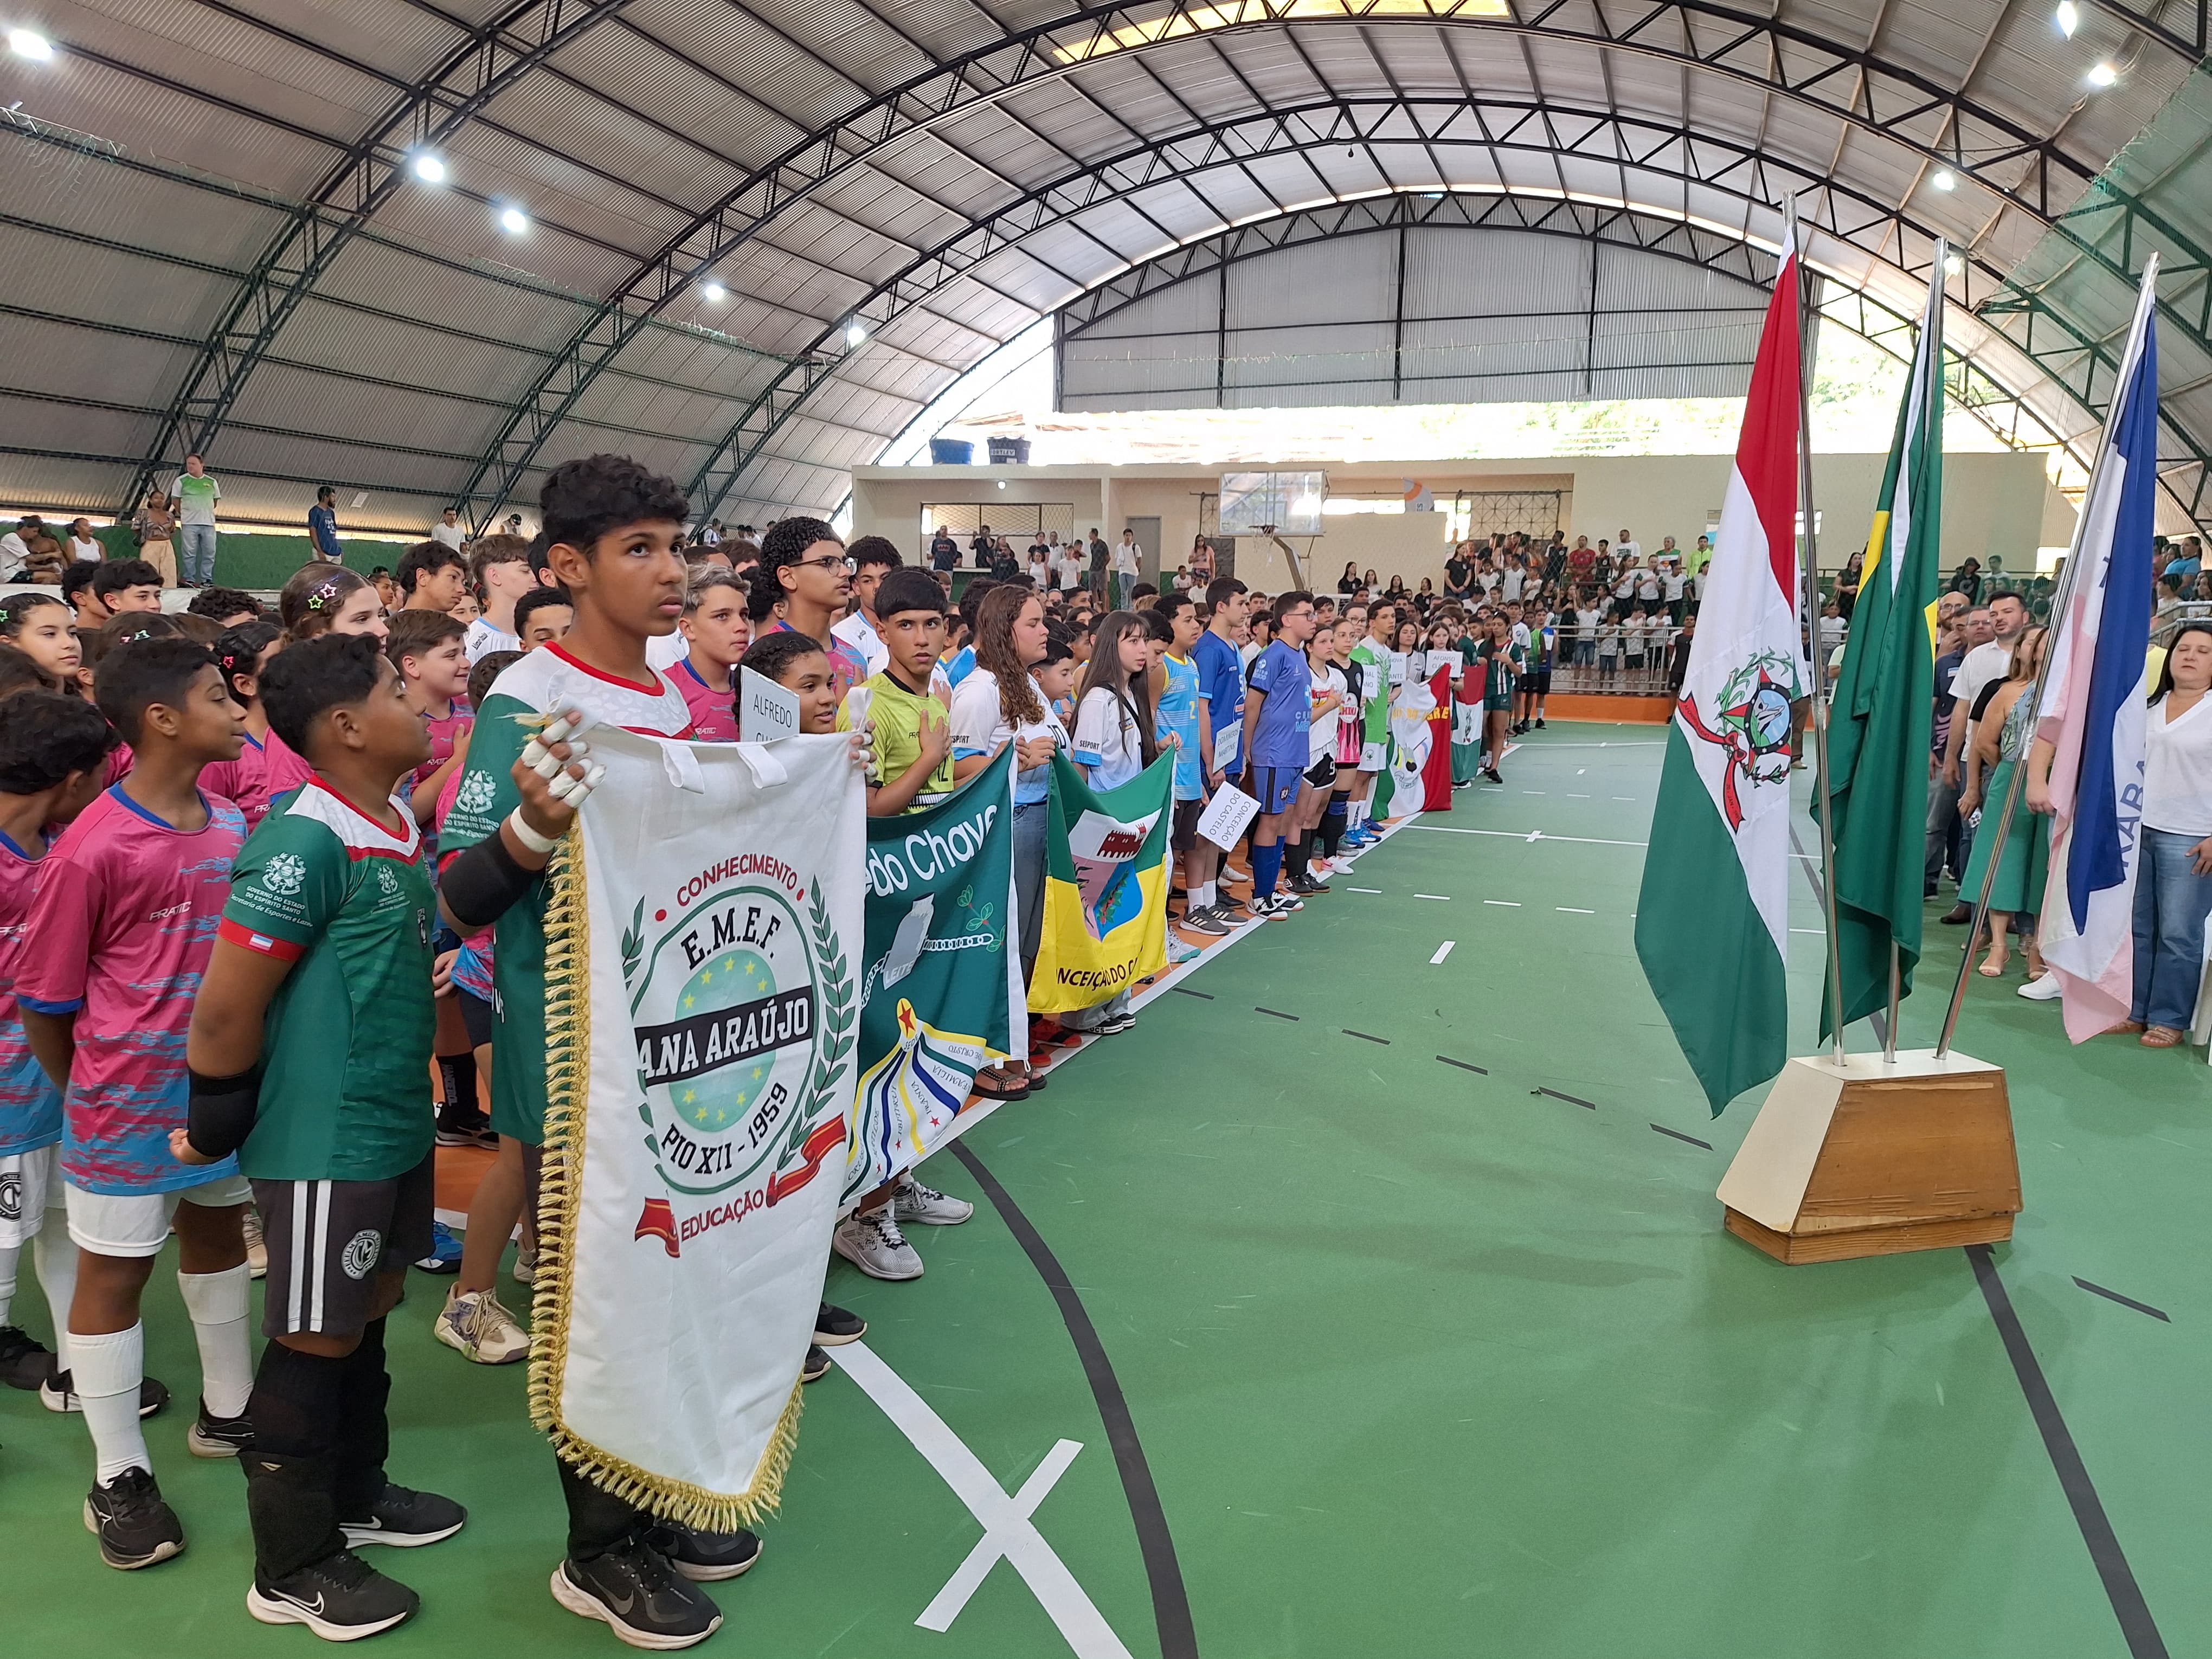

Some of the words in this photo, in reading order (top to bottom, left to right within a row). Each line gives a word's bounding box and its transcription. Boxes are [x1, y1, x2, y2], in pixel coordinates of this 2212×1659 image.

[753, 693, 792, 729] ALFREDO
[1079, 740, 1100, 751] SESPORT
[1218, 728, 1239, 747] DOMINGOS
[1218, 742, 1236, 758] MARTINS
[1230, 793, 1241, 805] DO
[1209, 805, 1232, 835] CASTELO
[1221, 801, 1251, 841] CONCEIÇÃO
[676, 853, 798, 907] CONHECIMENTO
[149, 901, 192, 921] PRATIC
[230, 893, 255, 909] Secretaria
[264, 907, 292, 921] Esportes
[296, 918, 313, 928] Lazer
[247, 885, 273, 899] GOVERNO
[284, 899, 305, 910] ESTADO
[253, 894, 282, 909] ESPÍRITO
[282, 904, 301, 915] SANTO
[680, 906, 781, 970] E.M.E.F.
[885, 959, 915, 985] LEITE
[1057, 966, 1111, 992] NCEIÇÃO
[1110, 964, 1126, 983] DO
[705, 996, 809, 1064] ARAÚJO
[904, 1034, 919, 1050] SEDE
[948, 1044, 974, 1057] CRISTO
[661, 1123, 696, 1169] PIO
[694, 1140, 734, 1175] XII
[747, 1082, 788, 1148] 1959
[681, 1189, 764, 1242] EDUCAÇÃO
